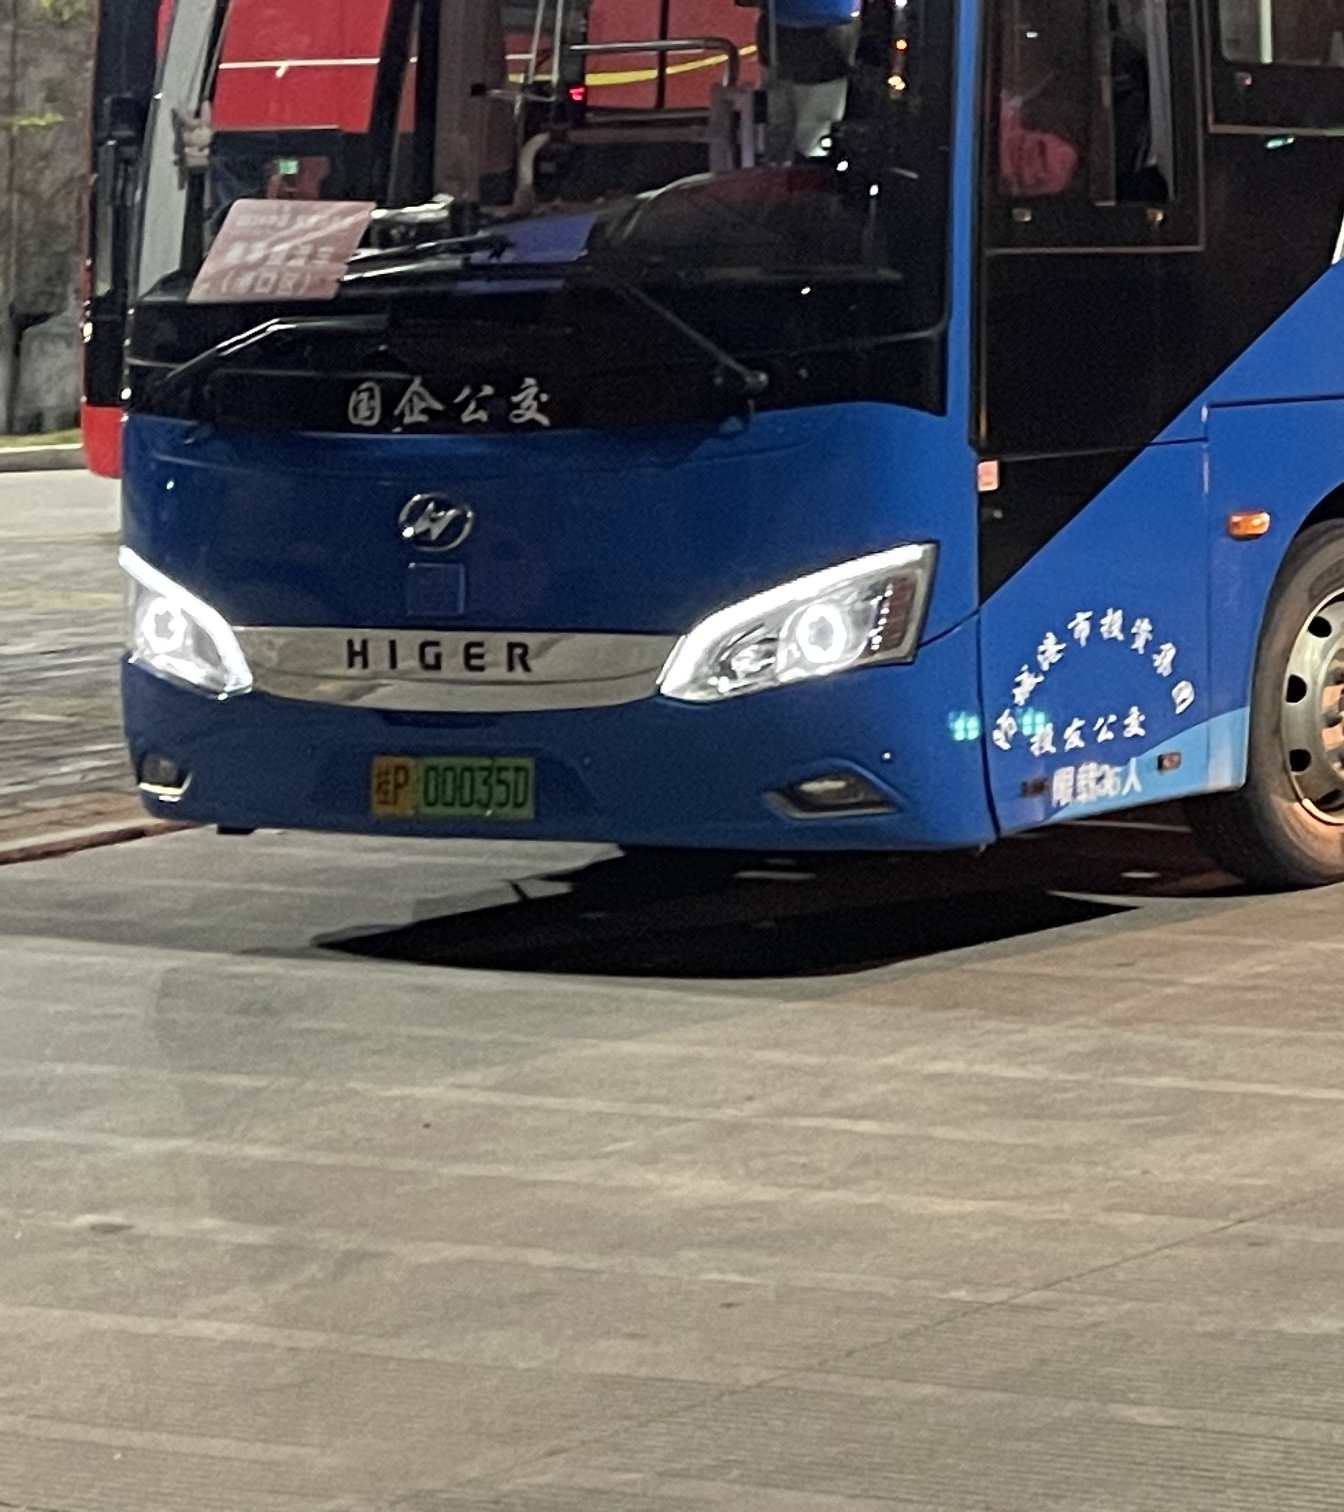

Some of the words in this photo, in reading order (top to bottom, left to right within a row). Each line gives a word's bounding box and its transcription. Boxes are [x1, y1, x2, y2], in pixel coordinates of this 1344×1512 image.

[348, 376, 550, 427] 国企公交
[346, 638, 532, 673] HIGER
[422, 764, 529, 809] 00035D
